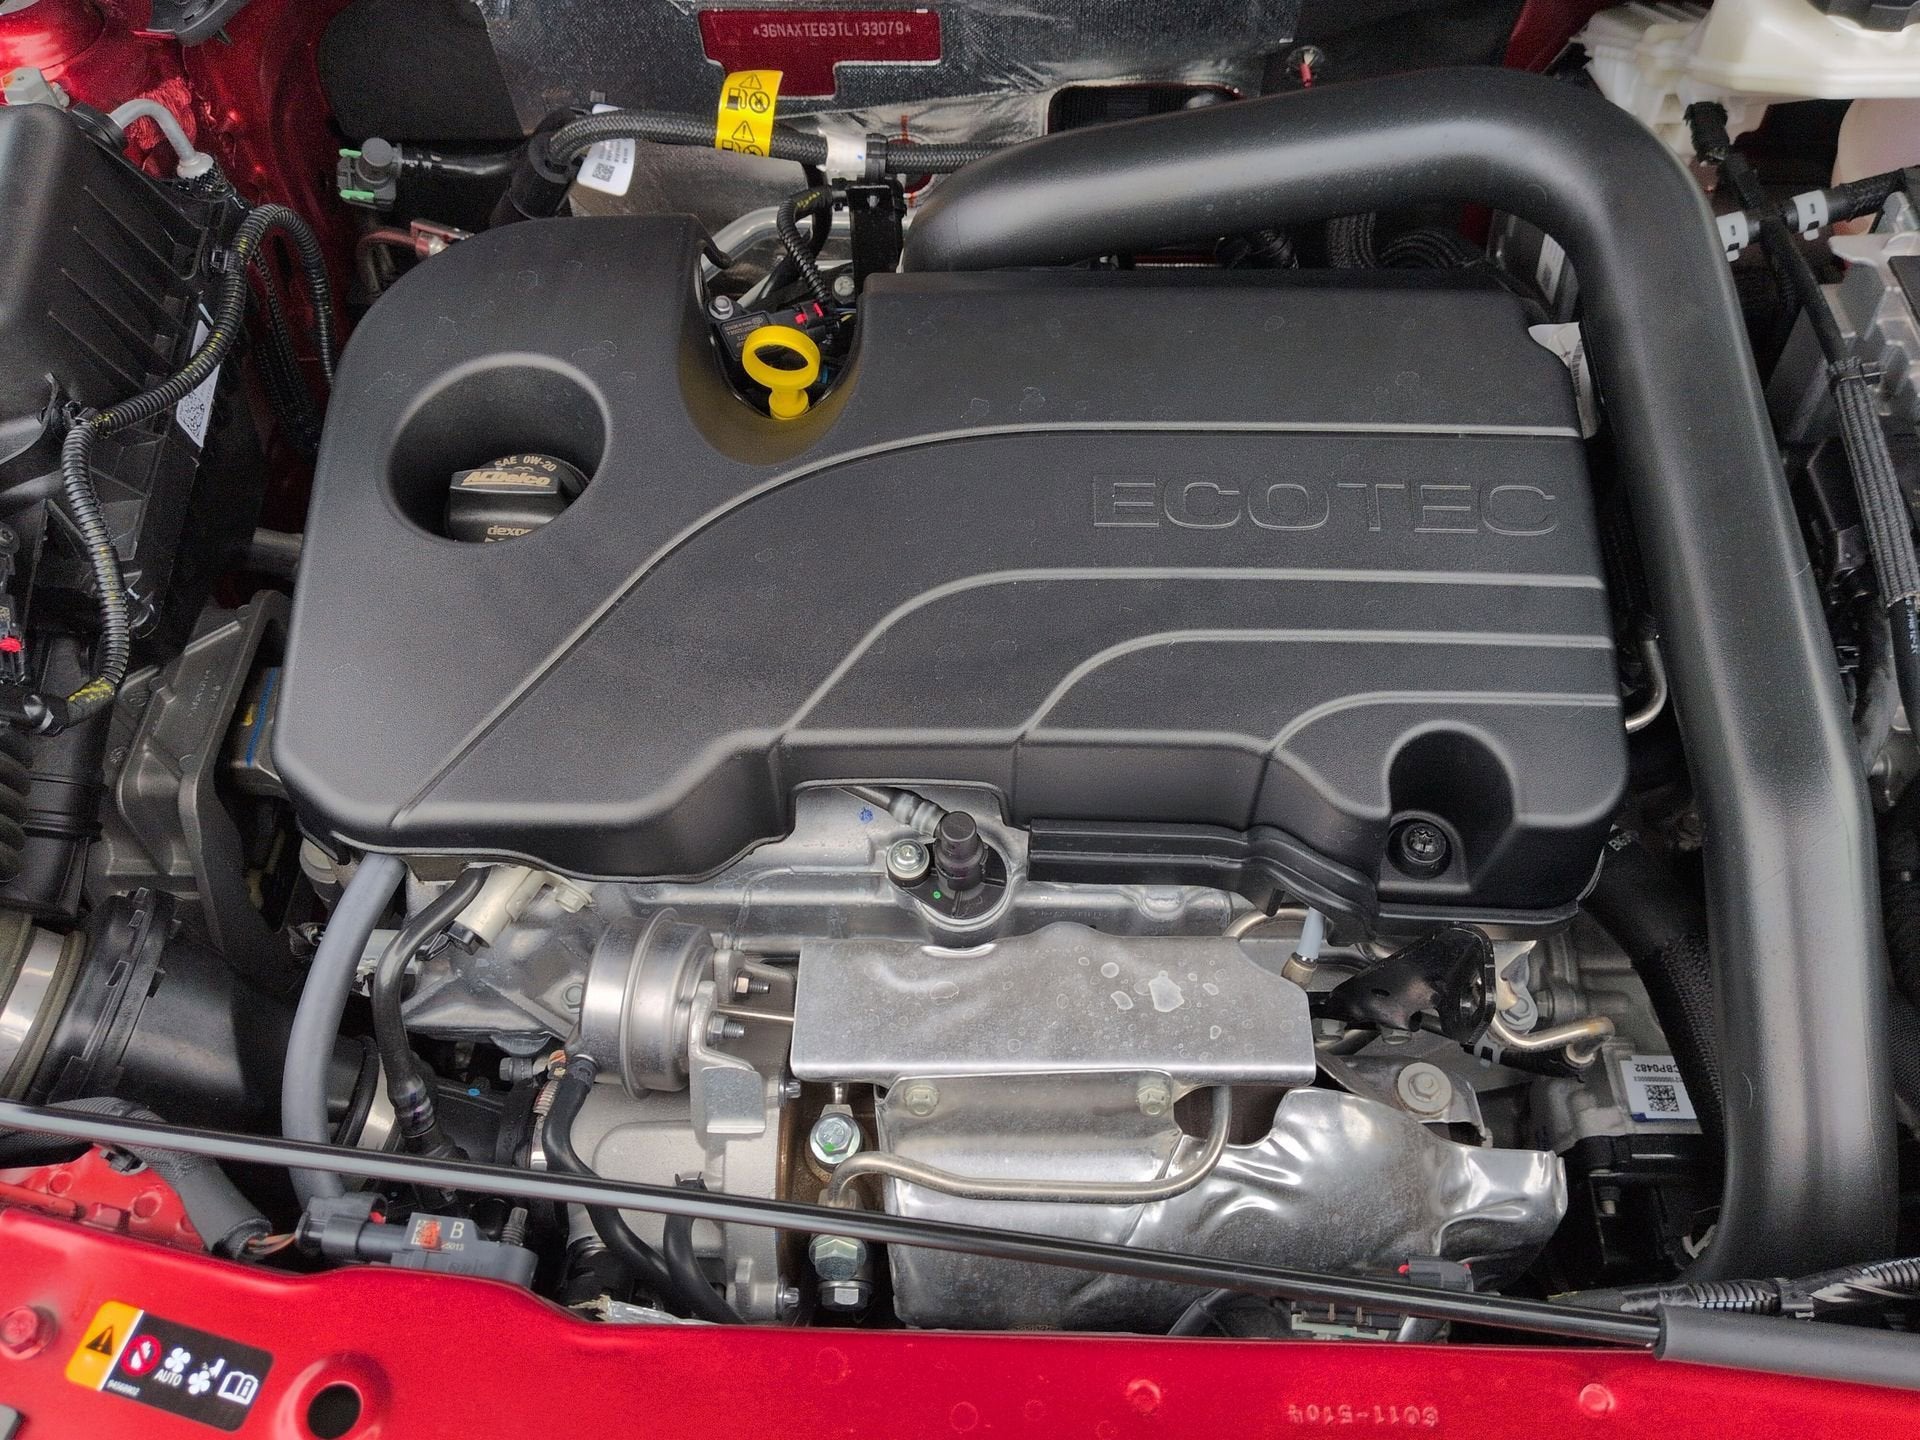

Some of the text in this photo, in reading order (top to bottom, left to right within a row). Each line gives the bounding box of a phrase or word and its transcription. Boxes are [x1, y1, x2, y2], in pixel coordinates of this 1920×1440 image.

[494, 455, 558, 472] SAE 0W-20
[461, 471, 551, 487] ACDelco
[1093, 476, 1559, 535] ECOTEC
[449, 1221, 465, 1239] B
[154, 1369, 183, 1387] AUTO
